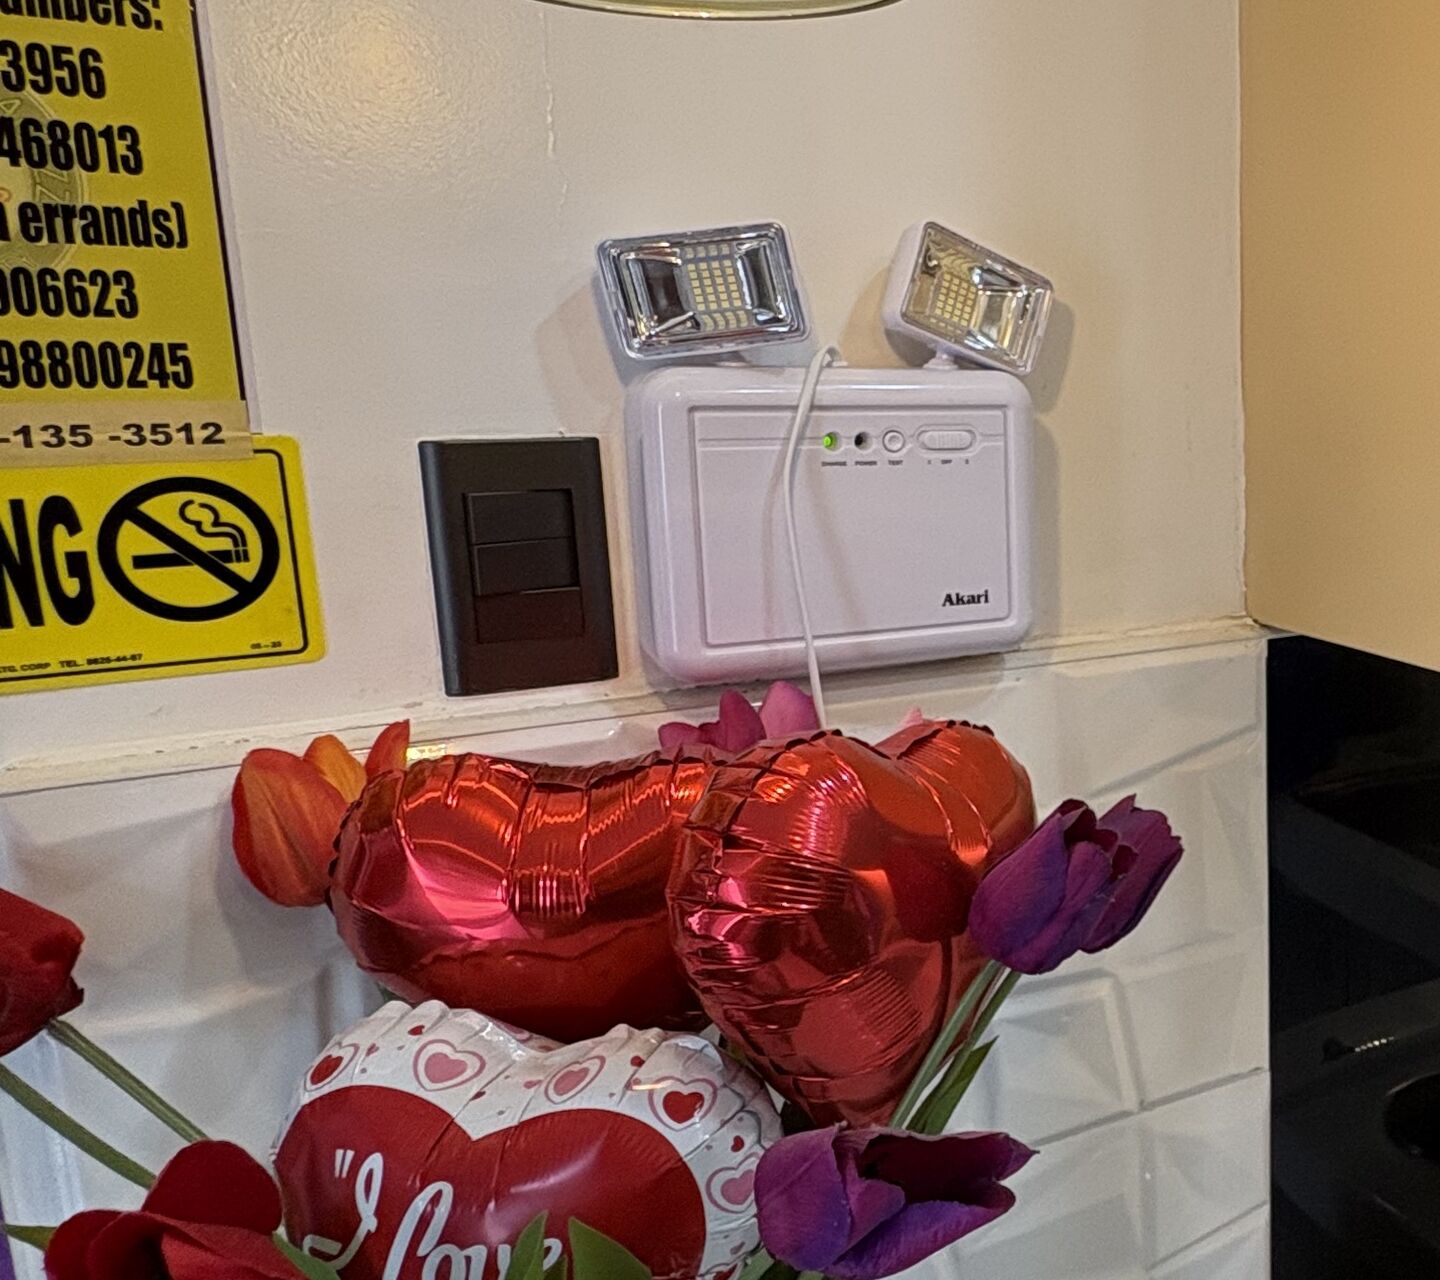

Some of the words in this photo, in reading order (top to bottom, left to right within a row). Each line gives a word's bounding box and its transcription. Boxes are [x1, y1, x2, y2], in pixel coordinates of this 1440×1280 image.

[0, 39, 106, 99] 3956
[18, 199, 188, 248] errands)
[0, 340, 194, 389] 98800245
[942, 589, 989, 607] Akari
